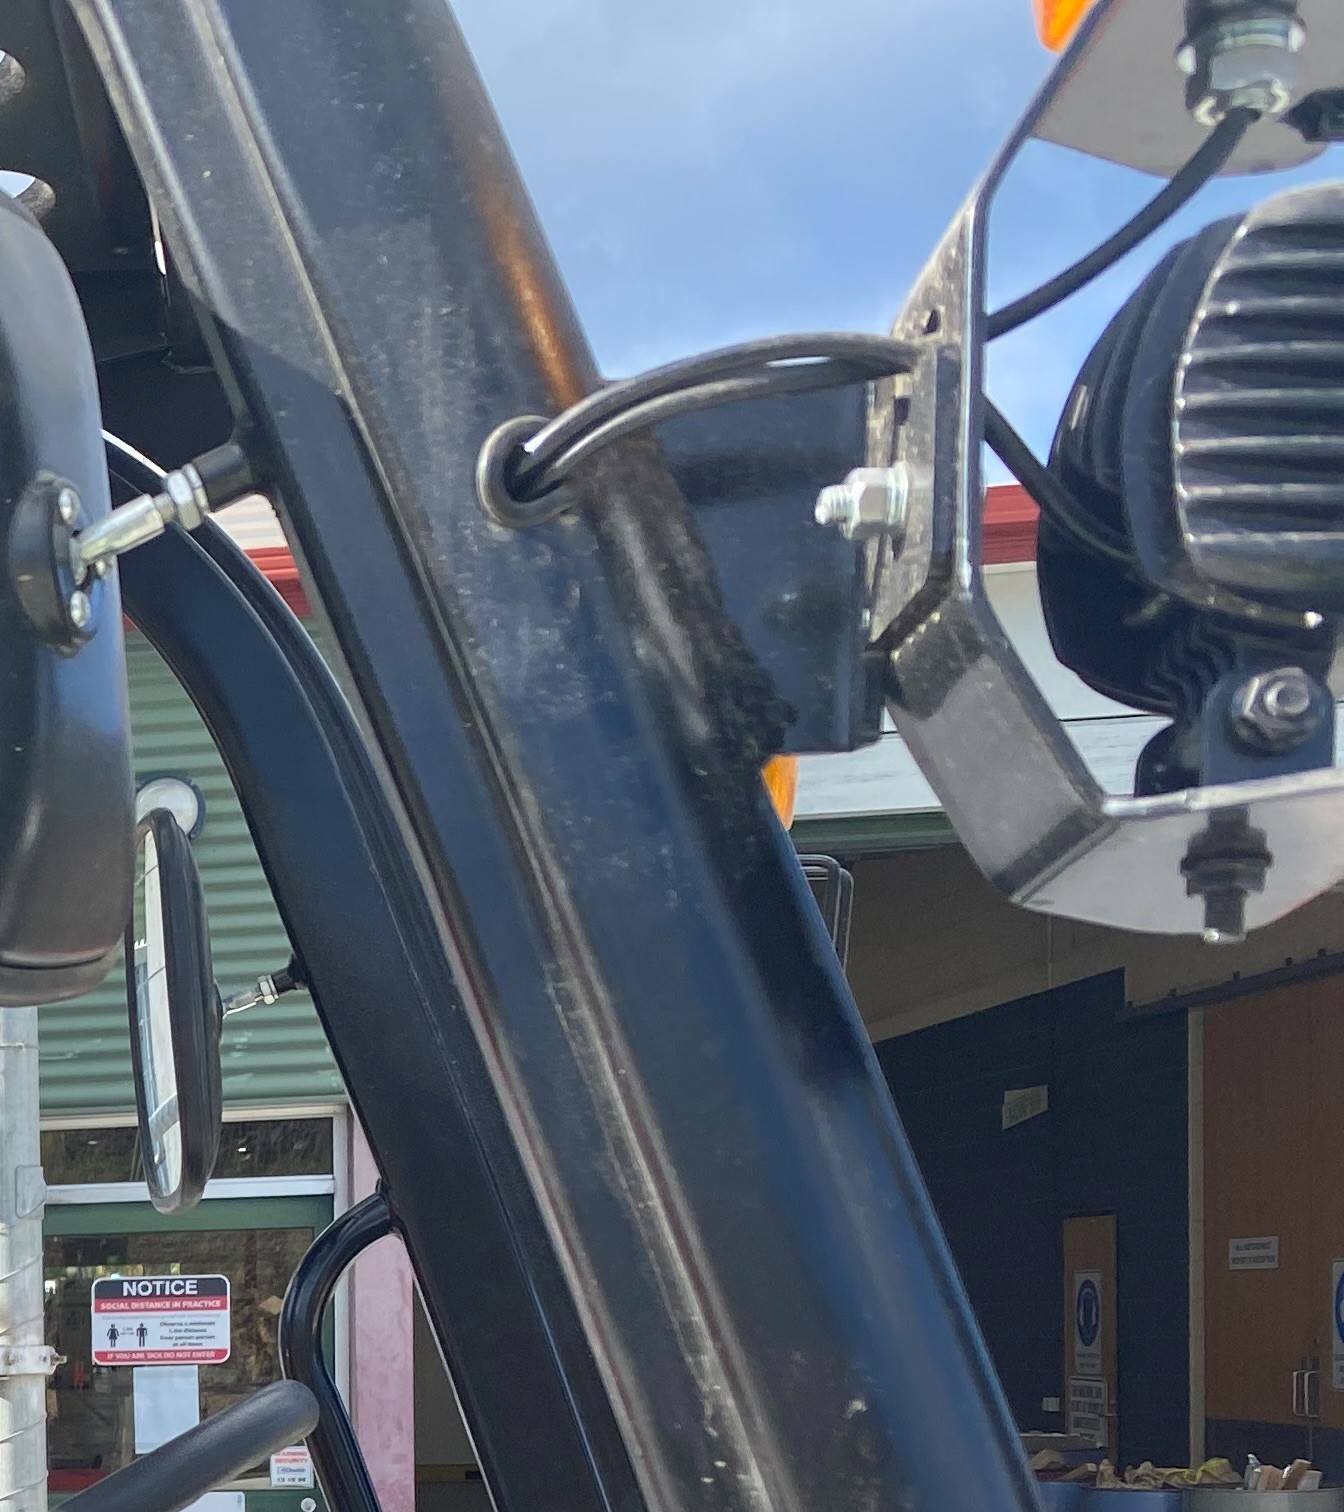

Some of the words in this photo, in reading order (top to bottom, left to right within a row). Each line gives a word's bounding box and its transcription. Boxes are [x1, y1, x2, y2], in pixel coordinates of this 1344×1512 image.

[122, 1279, 199, 1297] NOTICE
[100, 1301, 130, 1311] SOCIAL
[130, 1300, 171, 1310] DISTANCE
[172, 1300, 181, 1309] IN
[182, 1299, 221, 1309] PRACTICE
